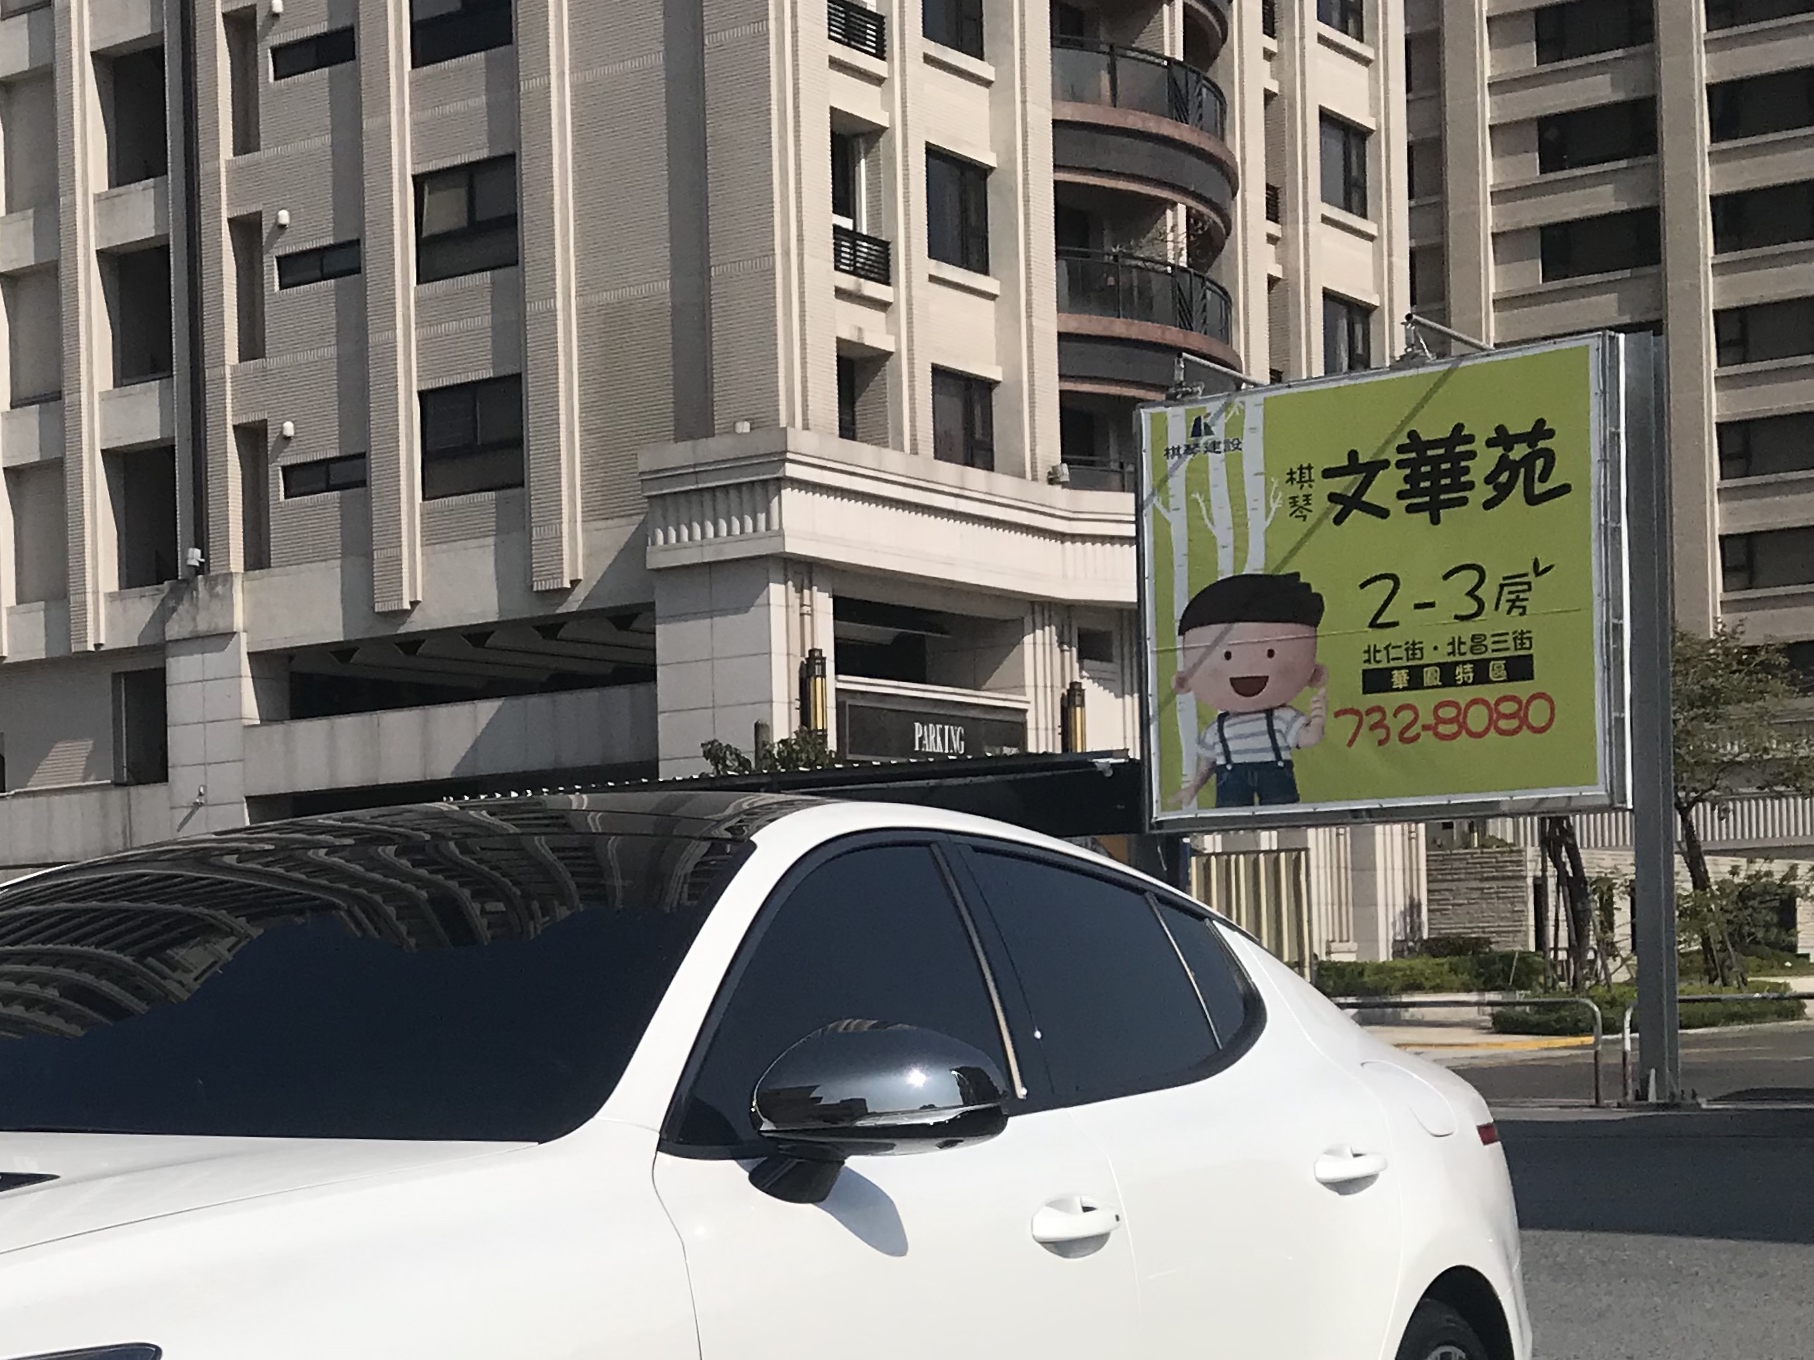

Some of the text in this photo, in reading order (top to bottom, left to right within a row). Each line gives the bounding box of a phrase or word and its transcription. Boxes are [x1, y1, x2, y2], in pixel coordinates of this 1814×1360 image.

[1286, 463, 1315, 522] 棋琴
[1321, 418, 1572, 527] 文華苑
[914, 722, 965, 754] PARKING
[1333, 692, 1556, 749] 732-8080
